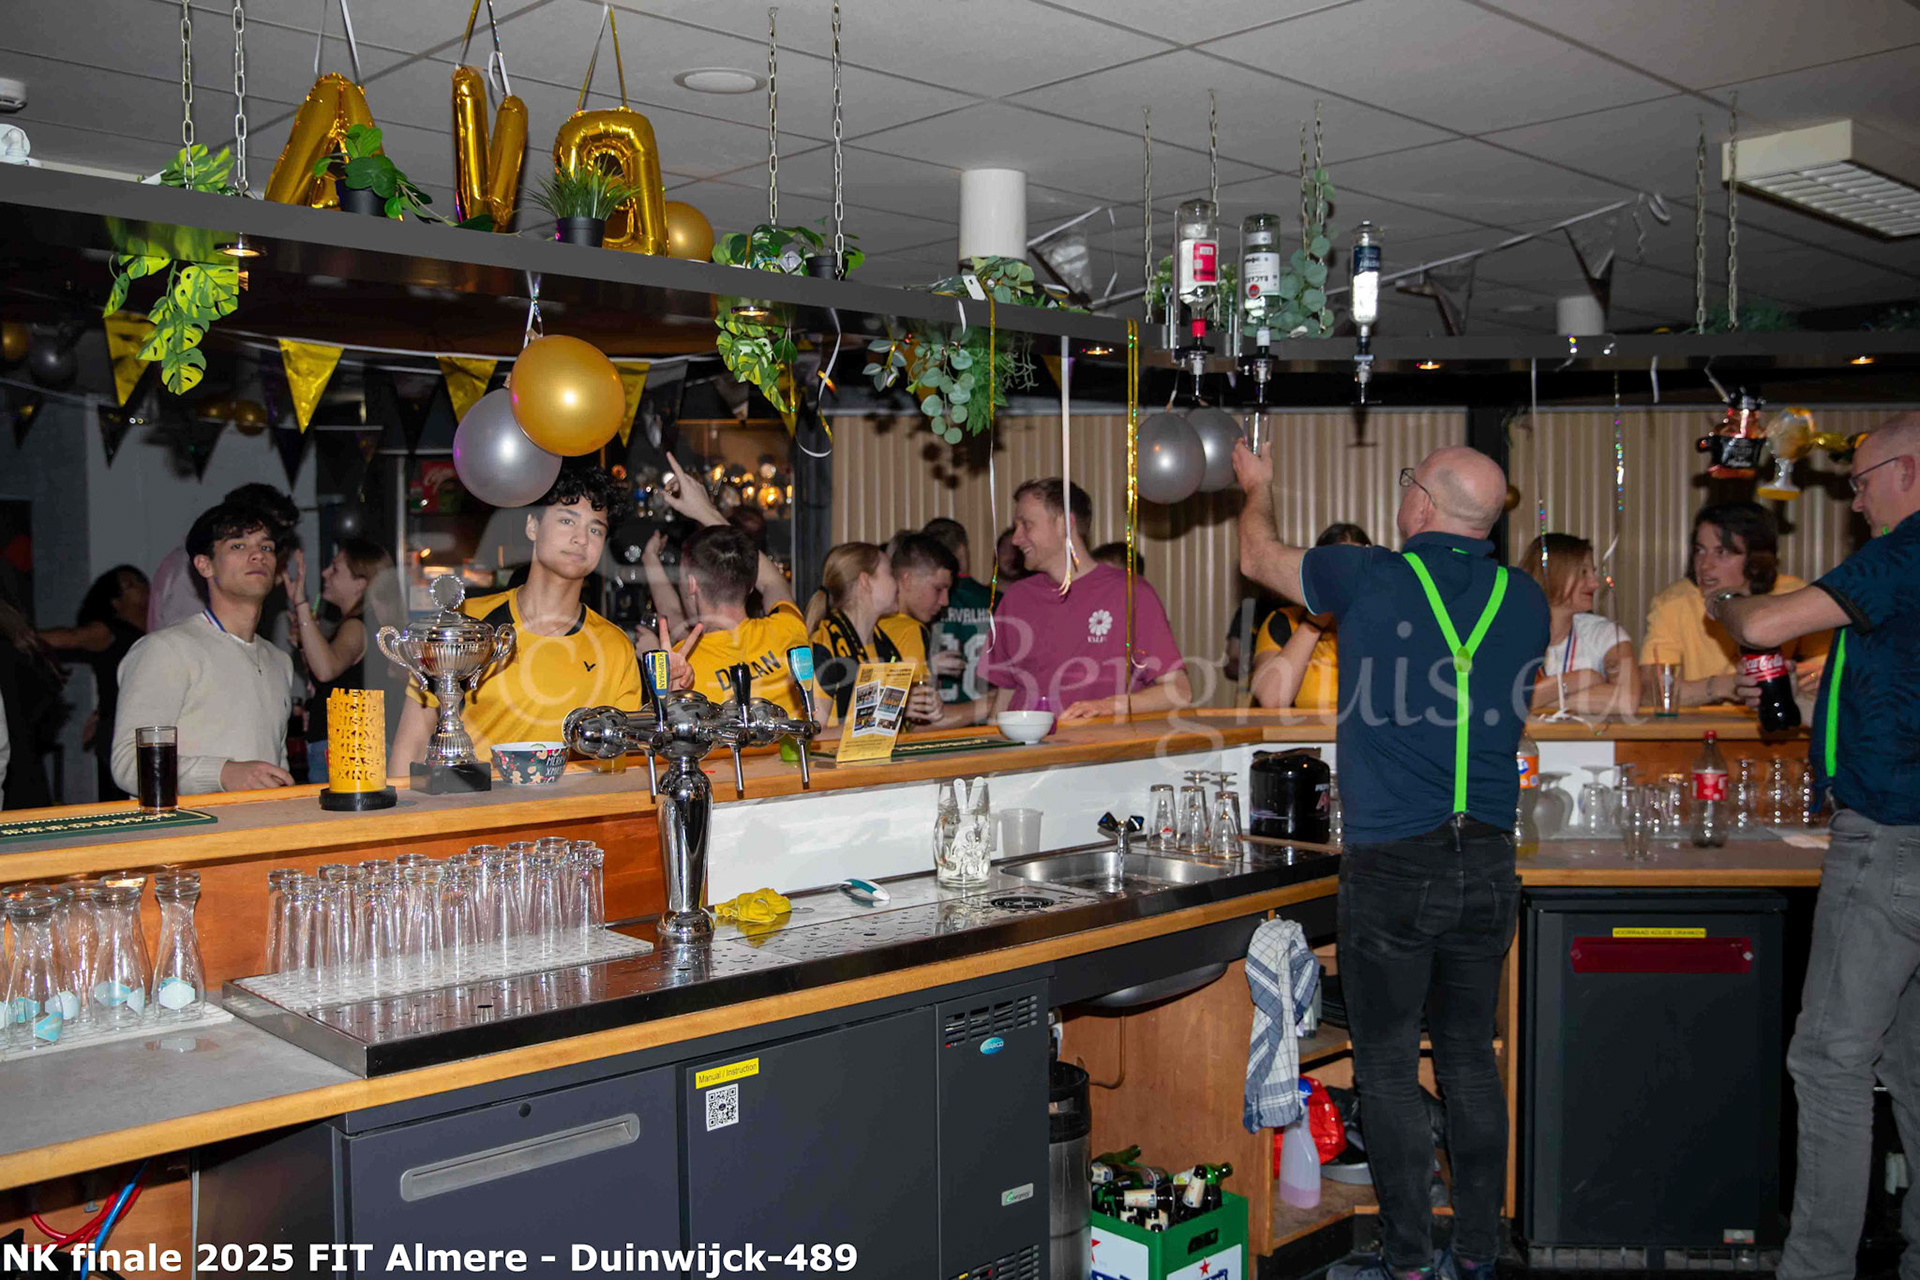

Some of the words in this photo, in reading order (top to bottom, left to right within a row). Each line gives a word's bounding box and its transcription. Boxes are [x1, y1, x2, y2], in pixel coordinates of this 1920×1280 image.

[657, 653, 666, 690] KEMPHAAN
[714, 650, 782, 692] DLAN
[698, 1070, 721, 1083] Manual
[726, 1063, 758, 1076] Instruction
